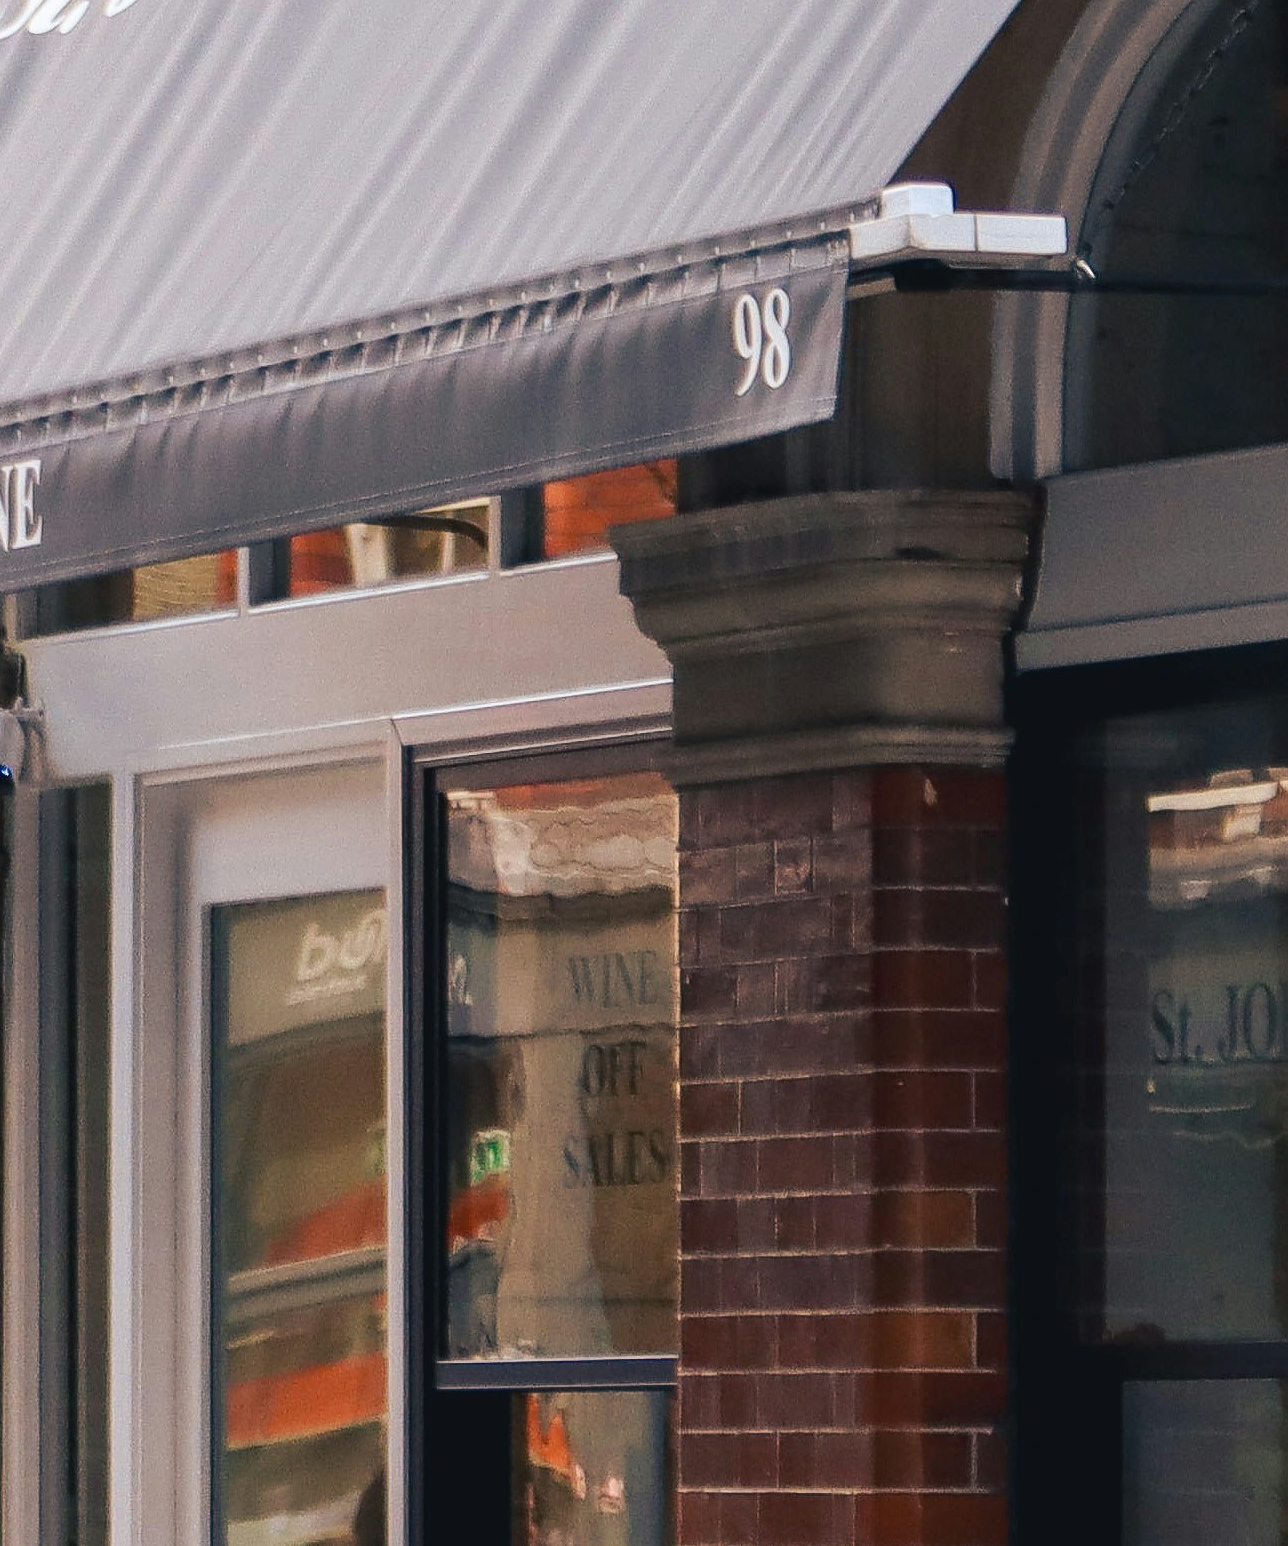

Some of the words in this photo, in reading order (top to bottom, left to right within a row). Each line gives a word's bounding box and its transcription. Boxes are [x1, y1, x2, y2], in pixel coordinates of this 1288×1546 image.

[732, 287, 791, 396] 98
[567, 949, 659, 1007] WINE
[1152, 990, 1203, 1065] St.
[563, 1131, 668, 1188] SALES
